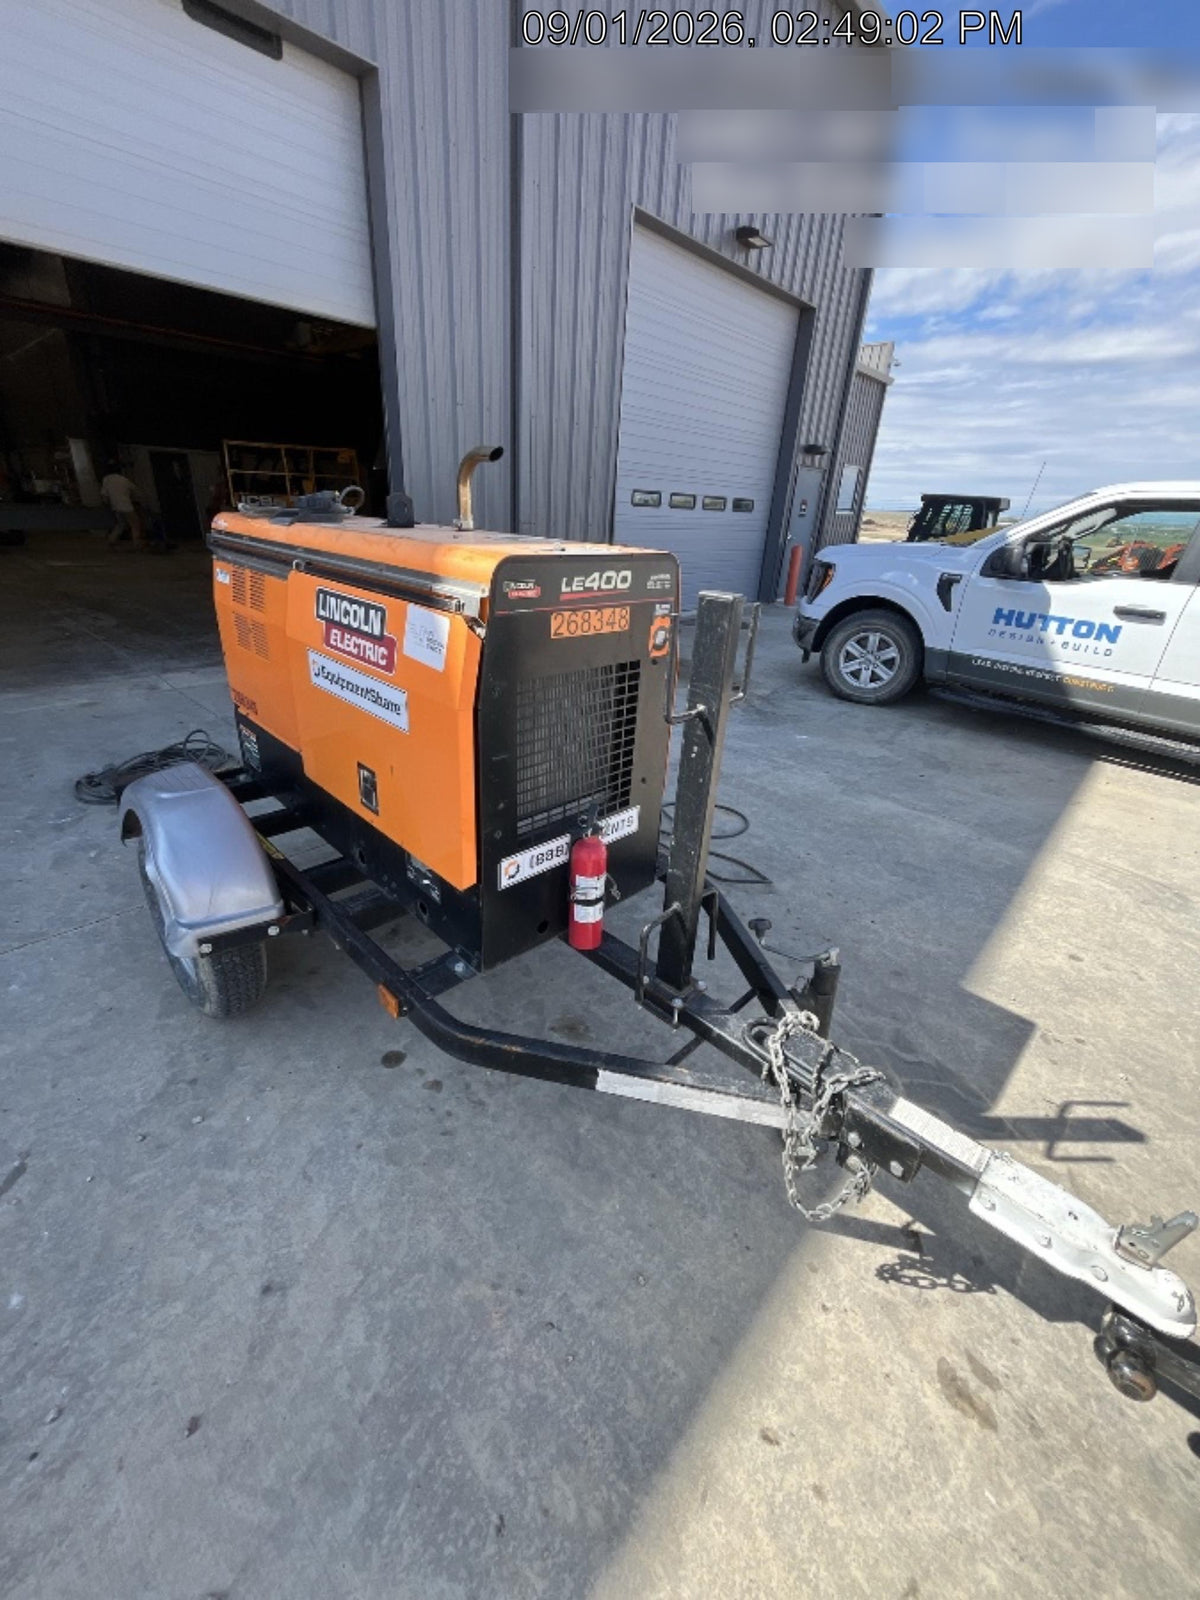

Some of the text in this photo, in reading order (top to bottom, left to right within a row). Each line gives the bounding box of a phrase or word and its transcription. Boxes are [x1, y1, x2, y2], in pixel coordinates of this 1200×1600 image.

[561, 570, 632, 592] LE400
[318, 593, 381, 635] LINCOLN
[553, 607, 629, 637] 268348
[992, 607, 1122, 643] HUTTON
[330, 629, 388, 666] ELECTRIC
[1061, 641, 1113, 657] BUILD
